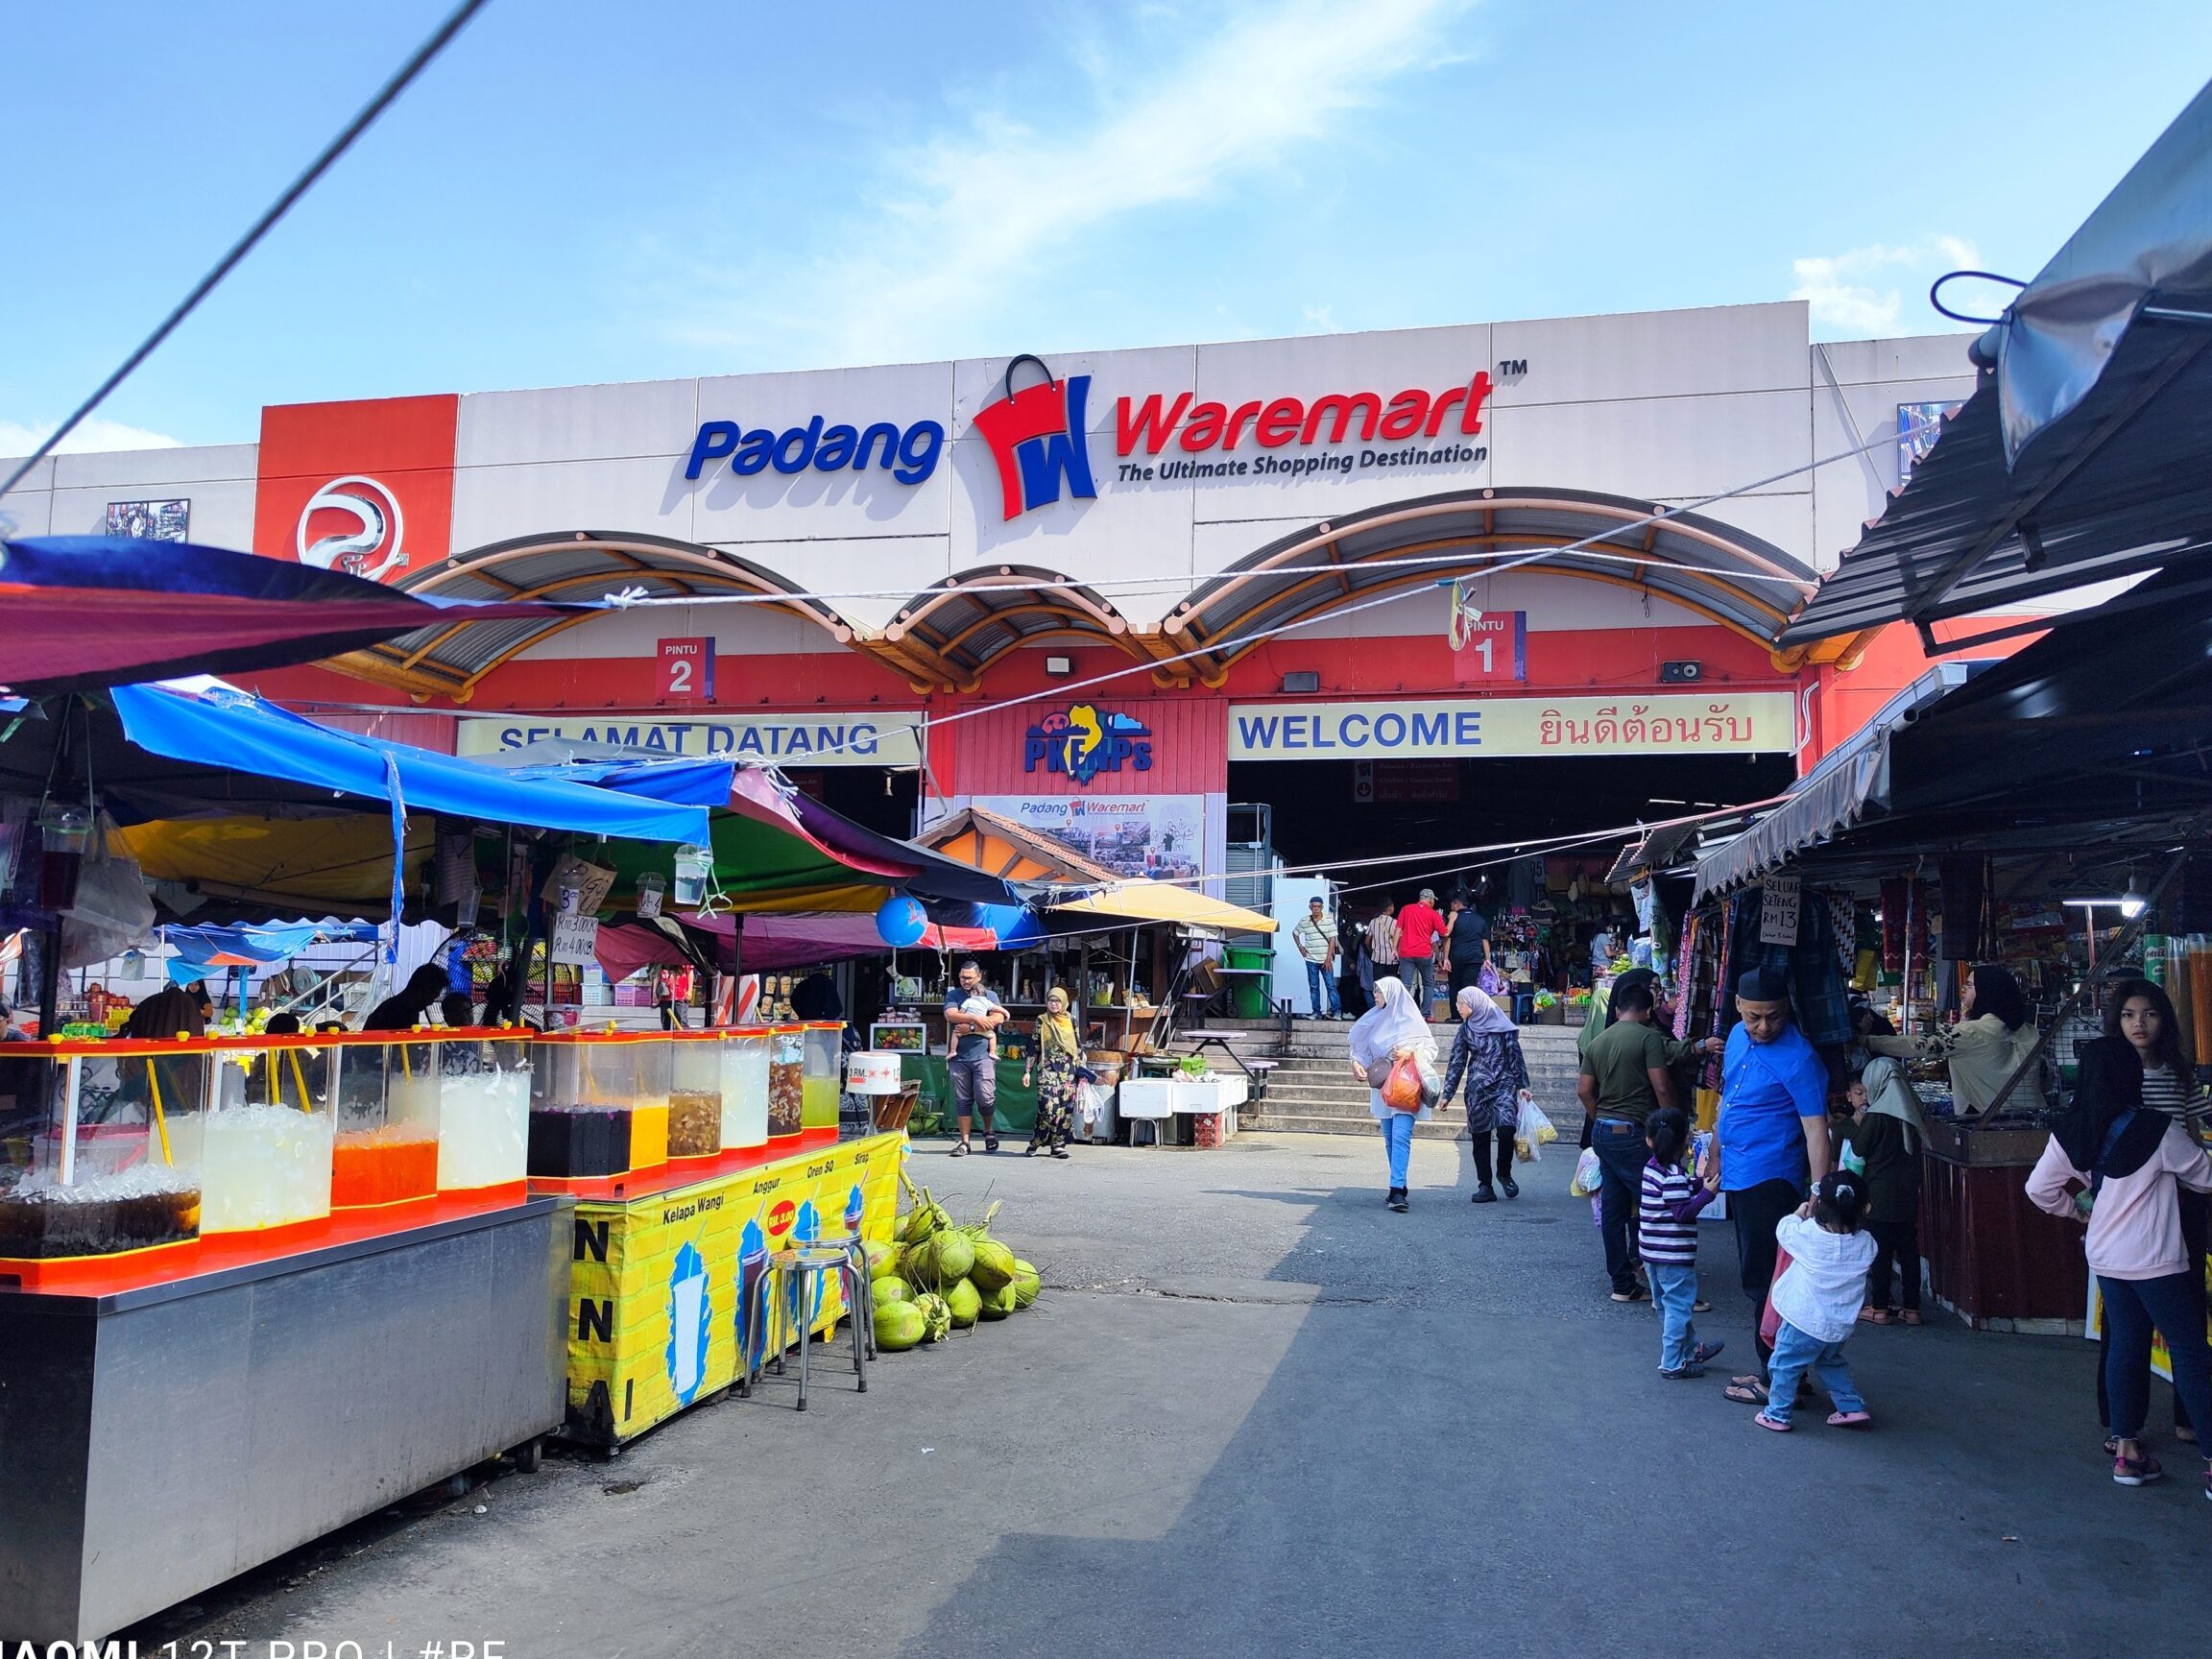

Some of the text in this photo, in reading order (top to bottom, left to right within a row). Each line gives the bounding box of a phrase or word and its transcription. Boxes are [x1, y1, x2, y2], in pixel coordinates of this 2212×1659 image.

[685, 415, 944, 485] Padang
[1116, 371, 1493, 457] Waremart
[1118, 445, 1488, 482] The Ultimate Shopping Destination
[665, 644, 698, 656] PINTU
[1475, 637, 1492, 673] 1
[669, 661, 692, 692] 2
[707, 724, 878, 756] DATANG
[1238, 711, 1482, 749] WELCOME
[1540, 704, 1753, 745] ยินดีต้อนรับ
[1021, 801, 1145, 816] Padang Waremart
[1764, 894, 1797, 908] SETENG
[753, 1177, 781, 1195] Anggur
[807, 1165, 823, 1179] Oren
[662, 1191, 725, 1225] Kelapa Wangi
